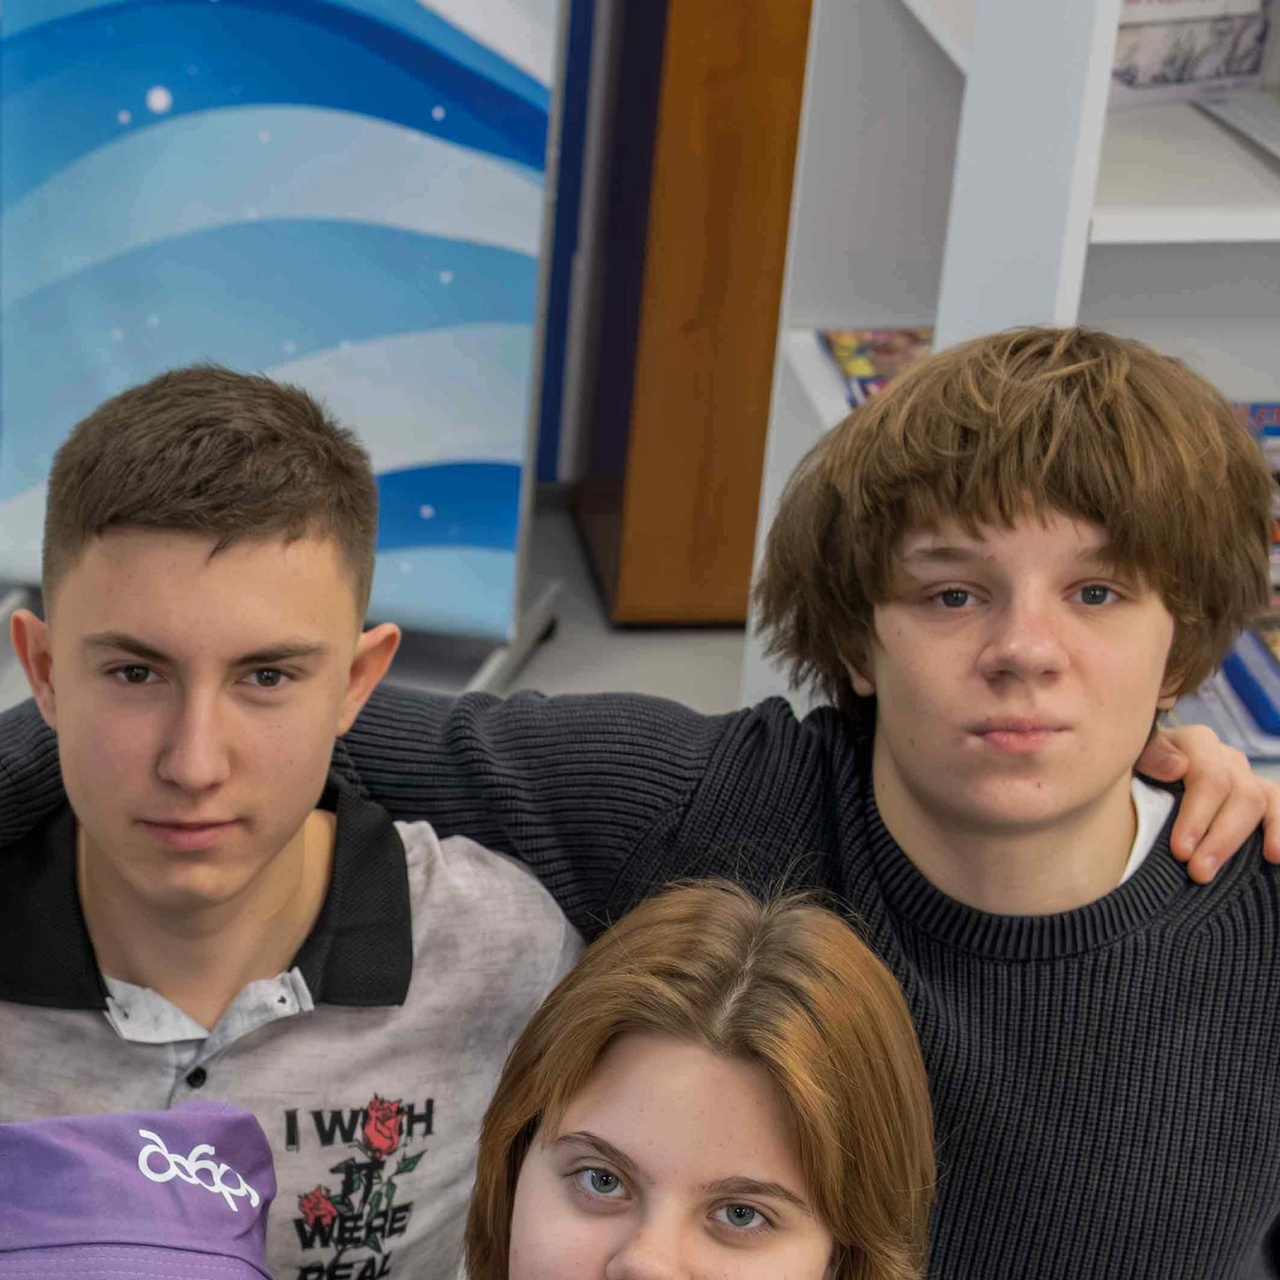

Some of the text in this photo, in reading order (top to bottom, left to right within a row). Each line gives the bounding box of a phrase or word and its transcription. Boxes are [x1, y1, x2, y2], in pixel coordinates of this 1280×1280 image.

[284, 1097, 434, 1148] I WH
[293, 1202, 414, 1251] WERE
